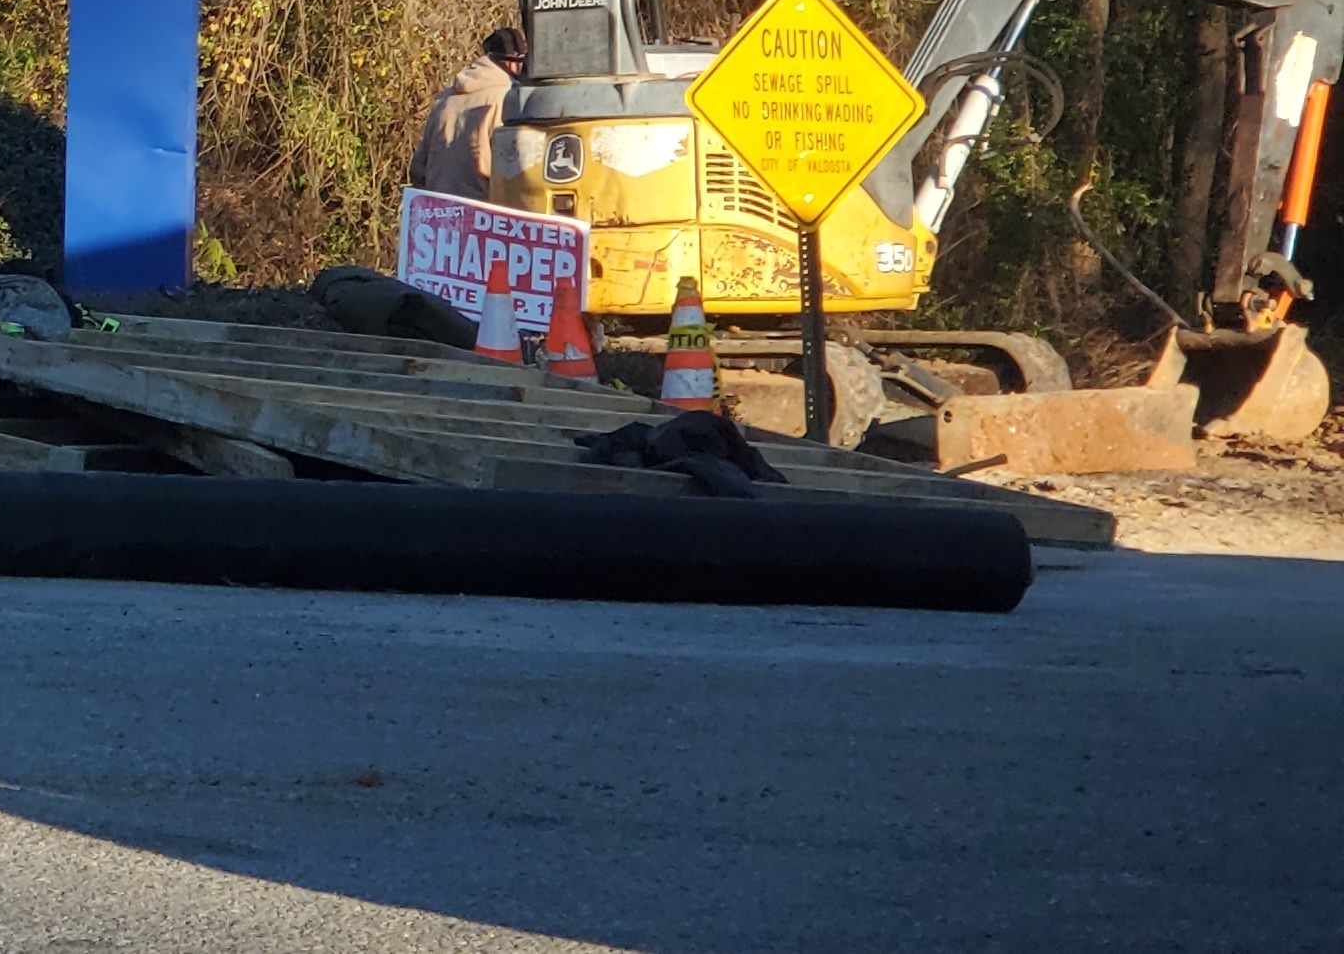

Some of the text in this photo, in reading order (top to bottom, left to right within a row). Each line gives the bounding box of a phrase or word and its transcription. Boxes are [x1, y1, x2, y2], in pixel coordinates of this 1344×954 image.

[761, 28, 843, 60] CAUTION
[753, 73, 853, 95] SEWAGE SPILL
[732, 101, 750, 119] NO
[765, 131, 845, 152] OR FISHING
[761, 158, 851, 174] CITY OF VALDOSTA
[474, 211, 576, 247] DEXTER
[414, 278, 477, 304] STATE
